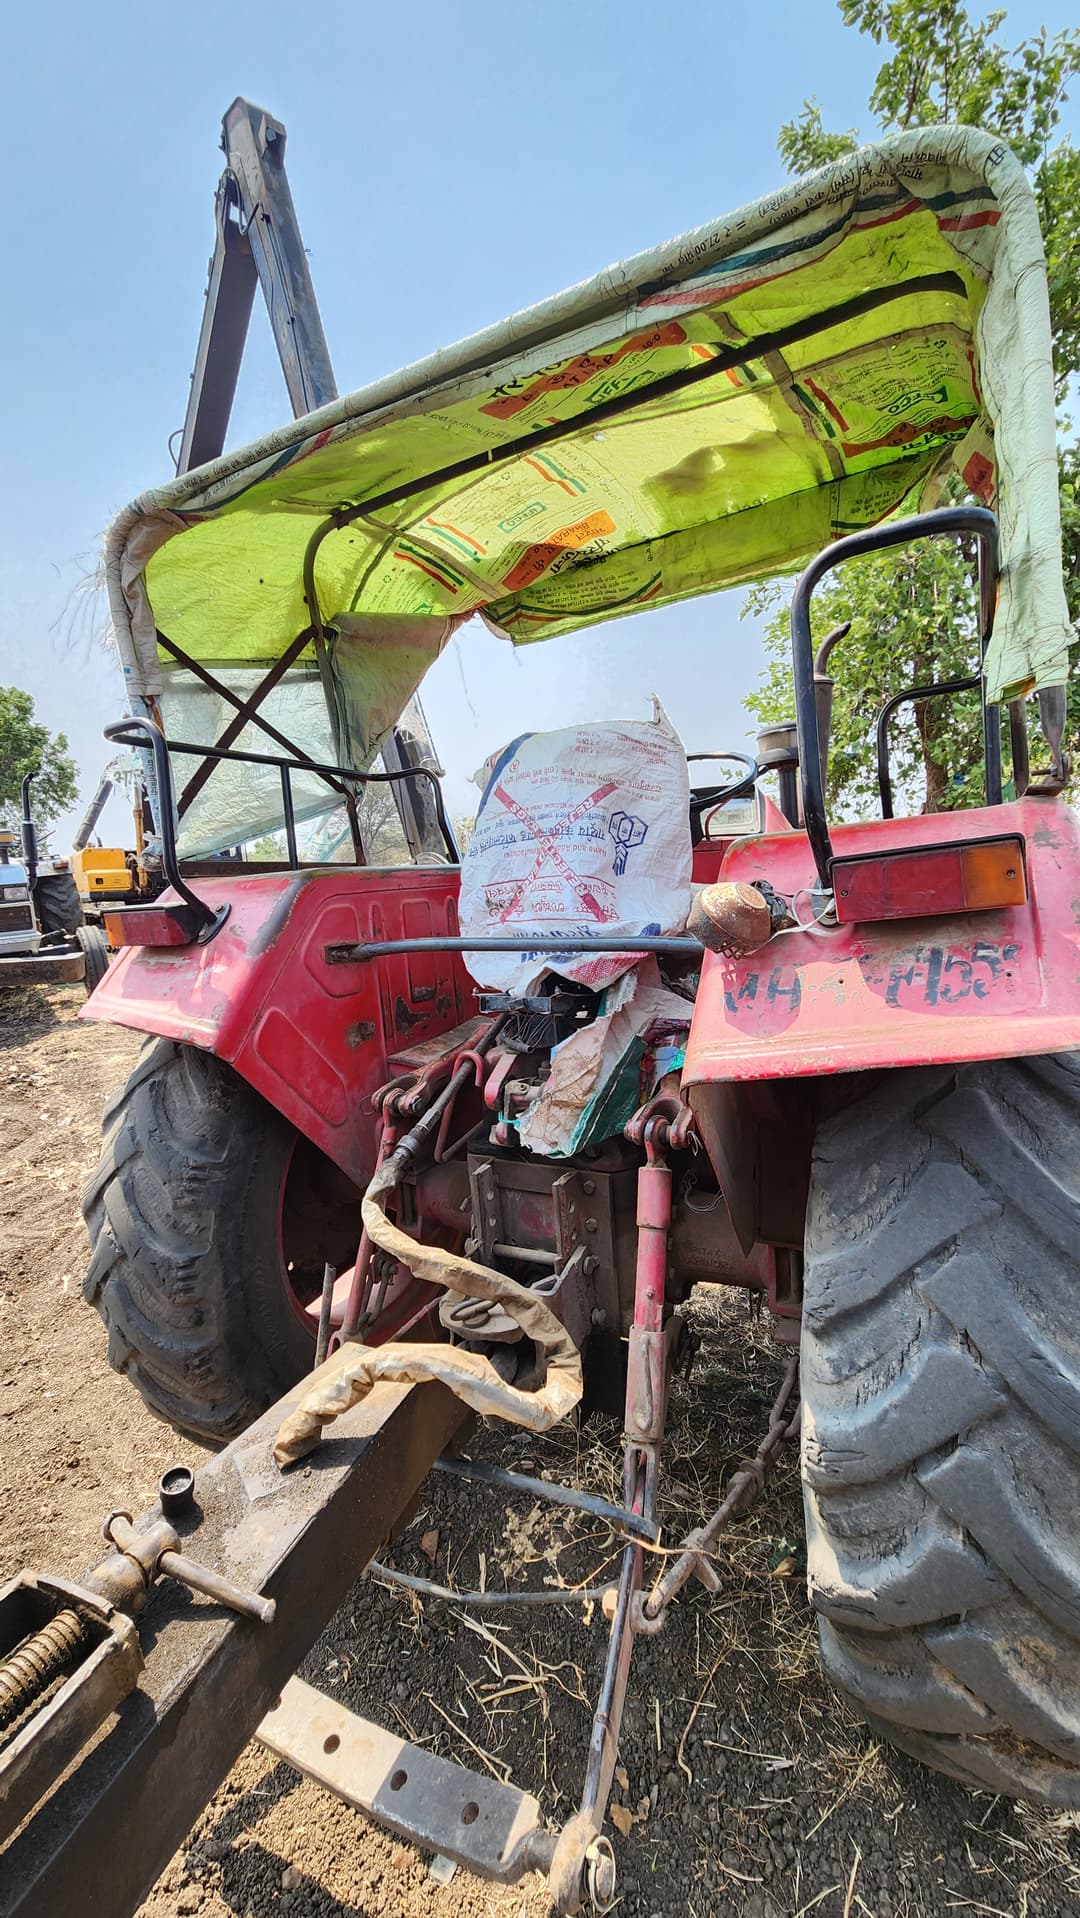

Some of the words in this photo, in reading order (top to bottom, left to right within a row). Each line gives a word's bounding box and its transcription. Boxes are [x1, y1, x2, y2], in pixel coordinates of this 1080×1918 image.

[692, 233, 722, 255] 27.00
[505, 508, 539, 526] IFFCO
[549, 523, 588, 544] BHARAT
[579, 823, 605, 841] राष्ट्रीय
